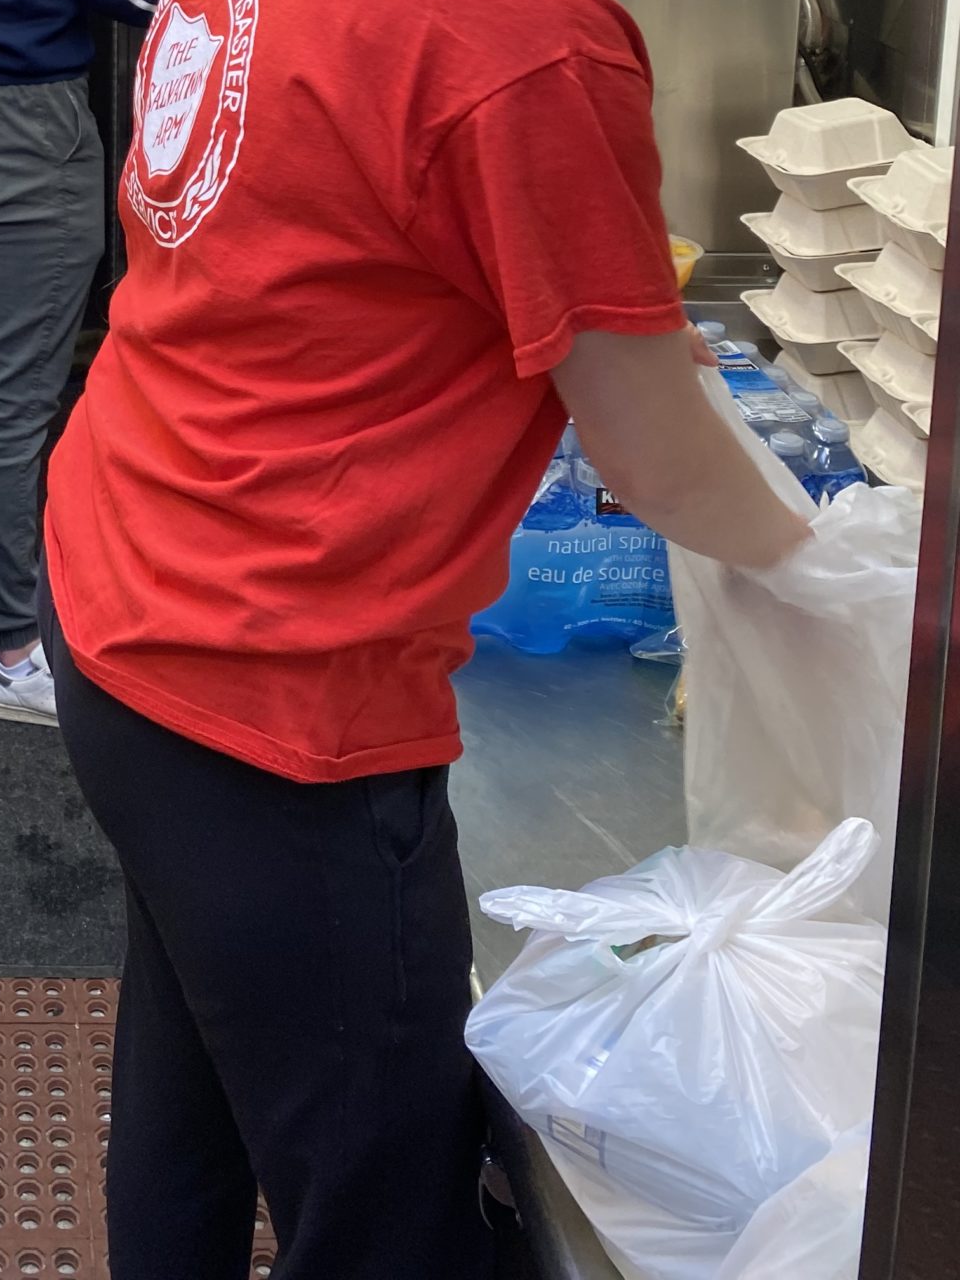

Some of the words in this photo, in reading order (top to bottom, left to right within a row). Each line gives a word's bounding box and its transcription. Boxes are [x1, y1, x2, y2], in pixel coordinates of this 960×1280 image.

[165, 37, 199, 71] THE
[153, 109, 191, 150] ARMY
[547, 532, 613, 555] natural
[618, 532, 670, 554] sprin
[527, 566, 566, 583] eau
[572, 566, 594, 584] de
[598, 565, 666, 582] source
